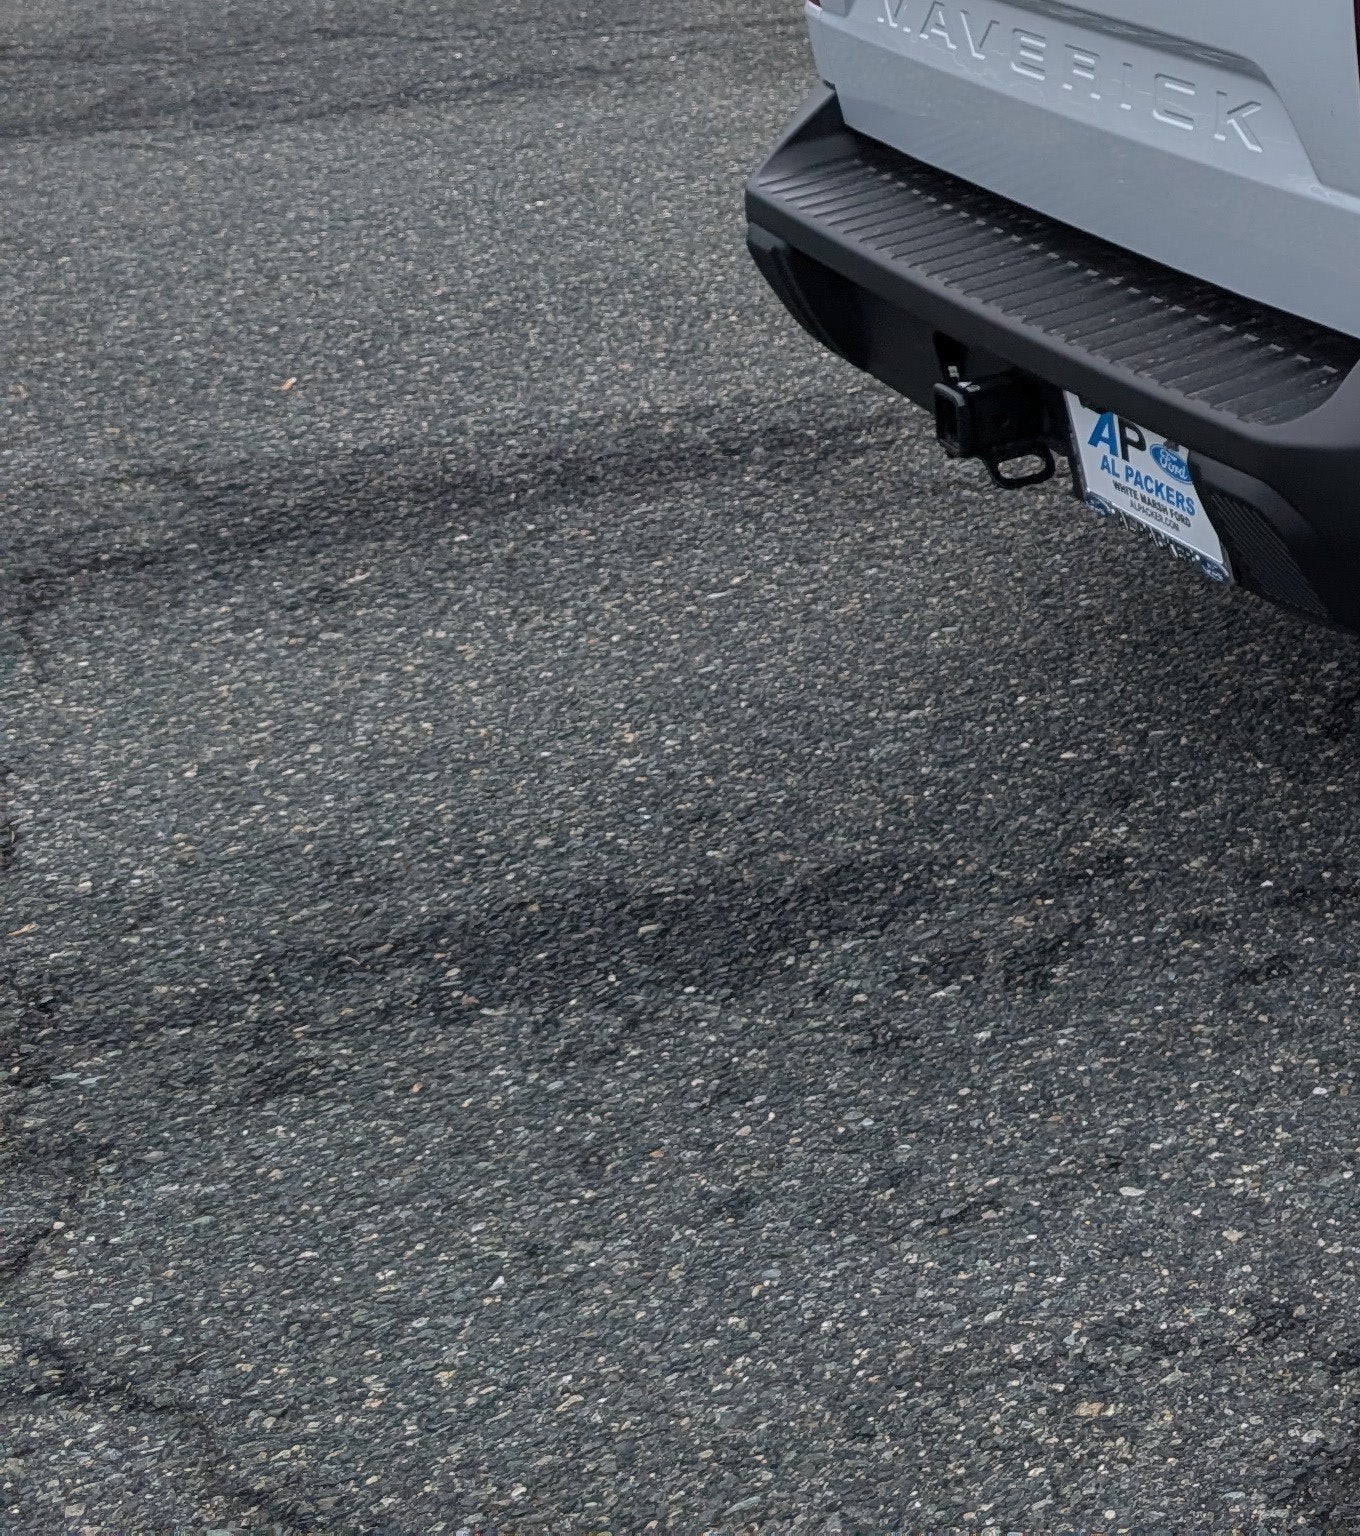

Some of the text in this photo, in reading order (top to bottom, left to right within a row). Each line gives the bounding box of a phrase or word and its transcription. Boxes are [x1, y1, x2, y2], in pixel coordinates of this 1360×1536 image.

[1087, 411, 1147, 463] AP
[1100, 454, 1121, 478] AL
[1124, 465, 1196, 517] PACKERS
[1158, 448, 1191, 481] Ford
[1112, 479, 1192, 528] WHITE MARSH FORD
